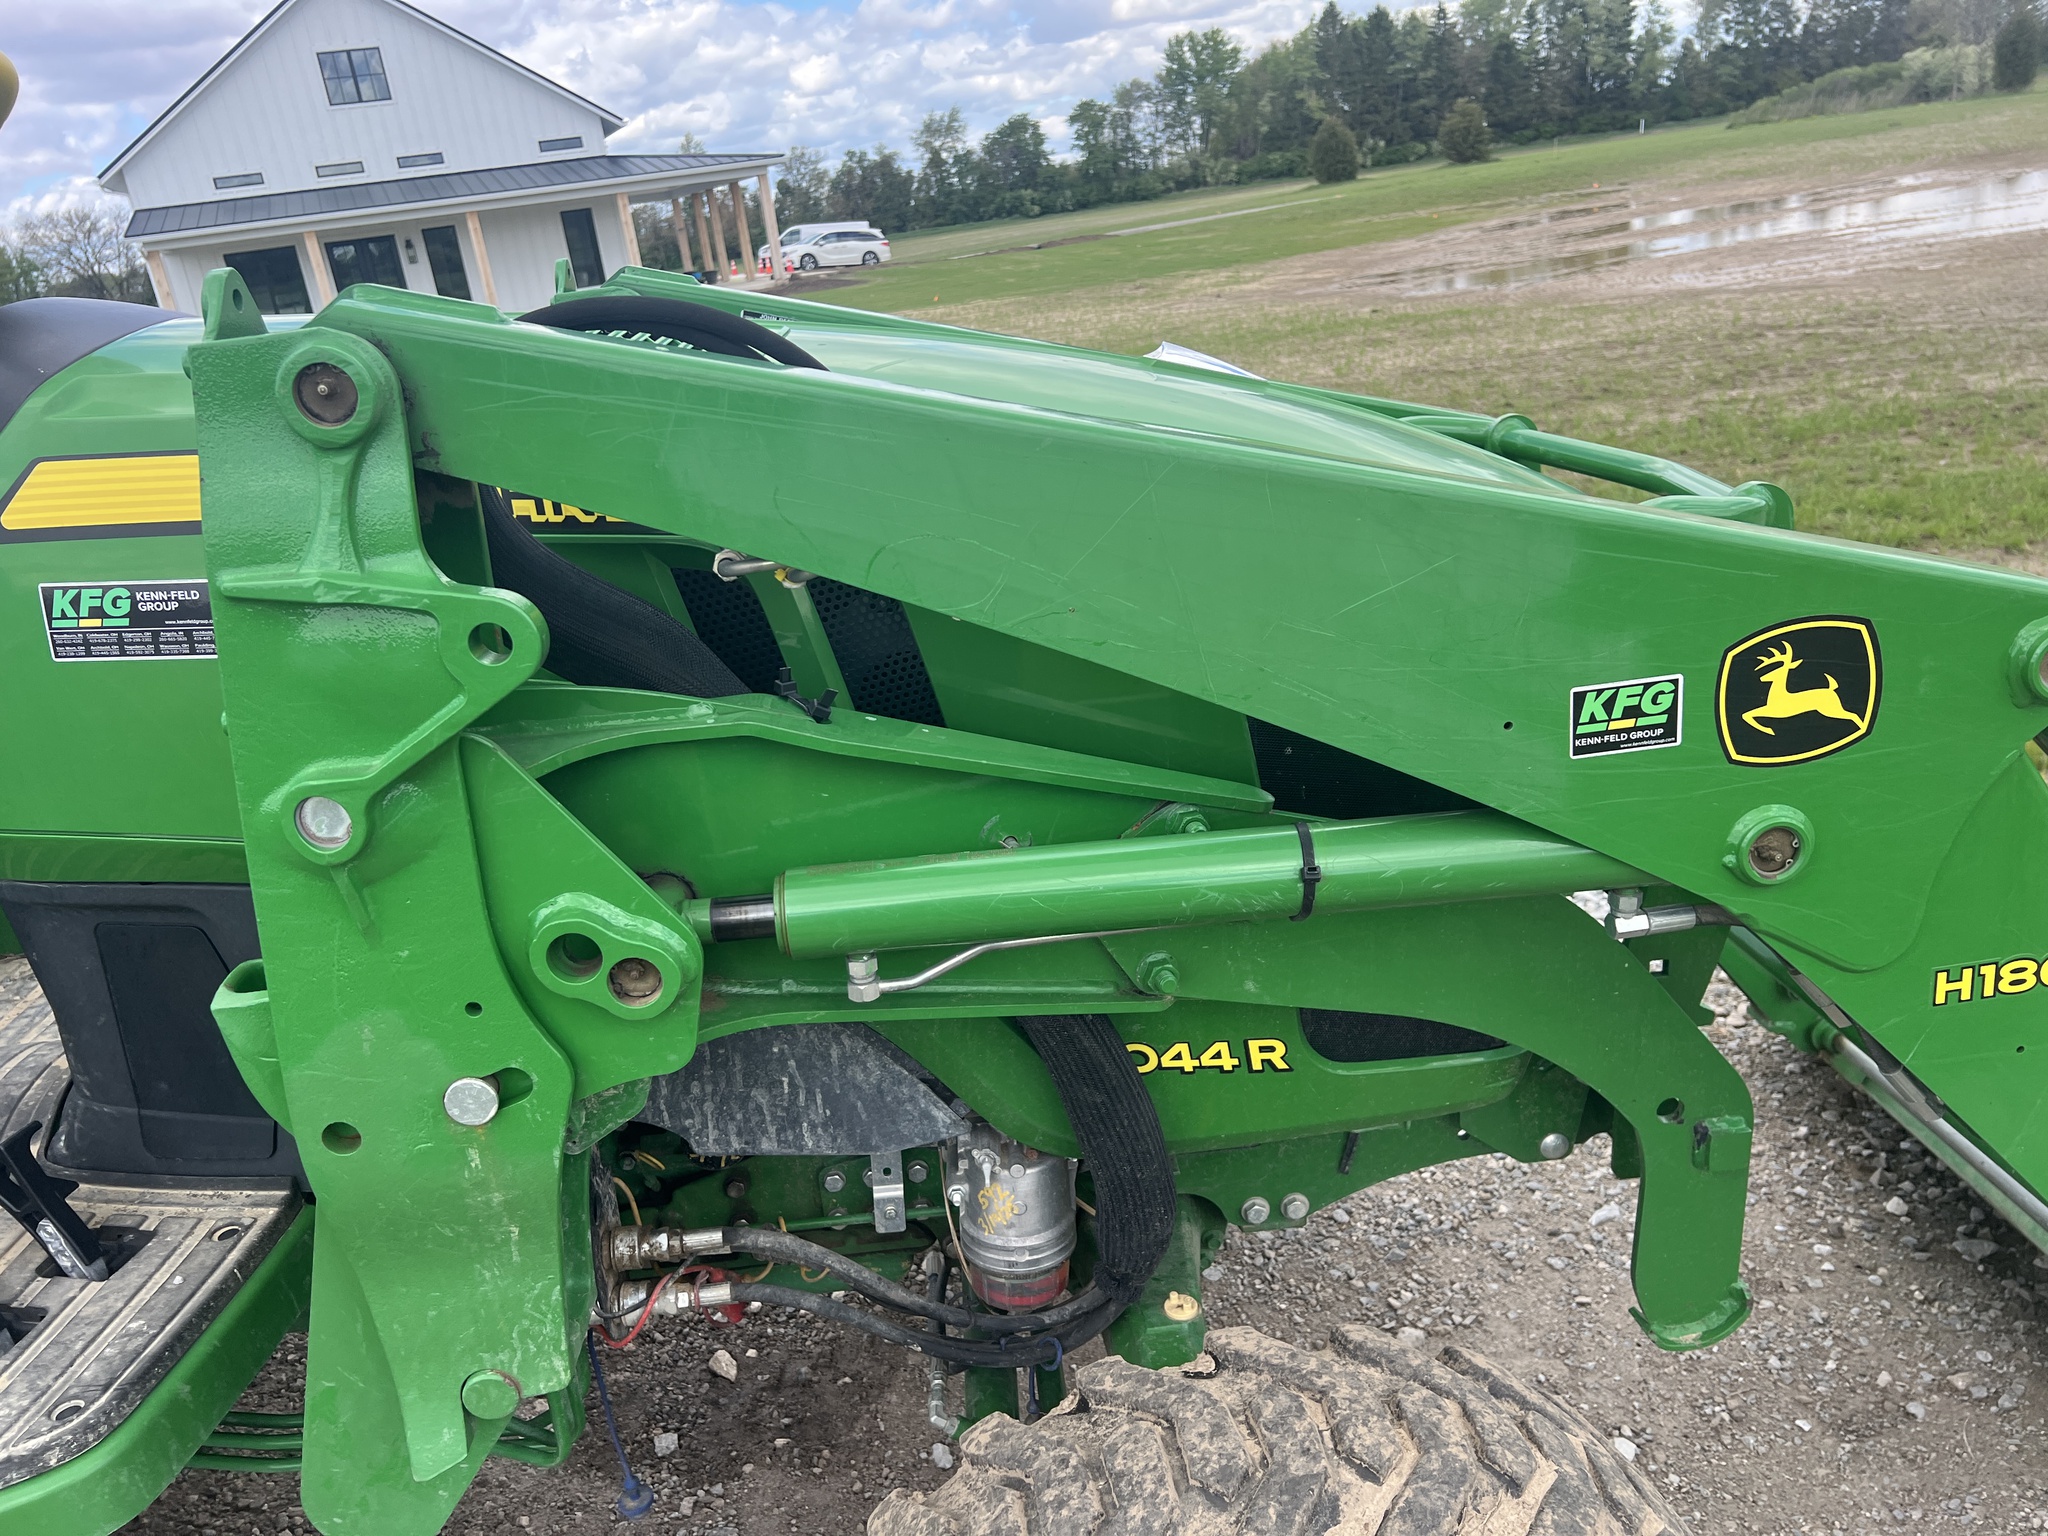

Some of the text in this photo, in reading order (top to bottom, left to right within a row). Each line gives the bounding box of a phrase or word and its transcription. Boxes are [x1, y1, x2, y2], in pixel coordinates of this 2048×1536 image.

[52, 587, 131, 618] KFG
[136, 590, 200, 601] KENN-FELD
[138, 601, 179, 612] GROUP
[1579, 681, 1676, 724] KFG
[1575, 732, 1628, 747] KENN-FELD
[1630, 728, 1664, 740] GROUP
[1934, 958, 2048, 1006] H18
[1125, 1039, 1293, 1075] 044 R
